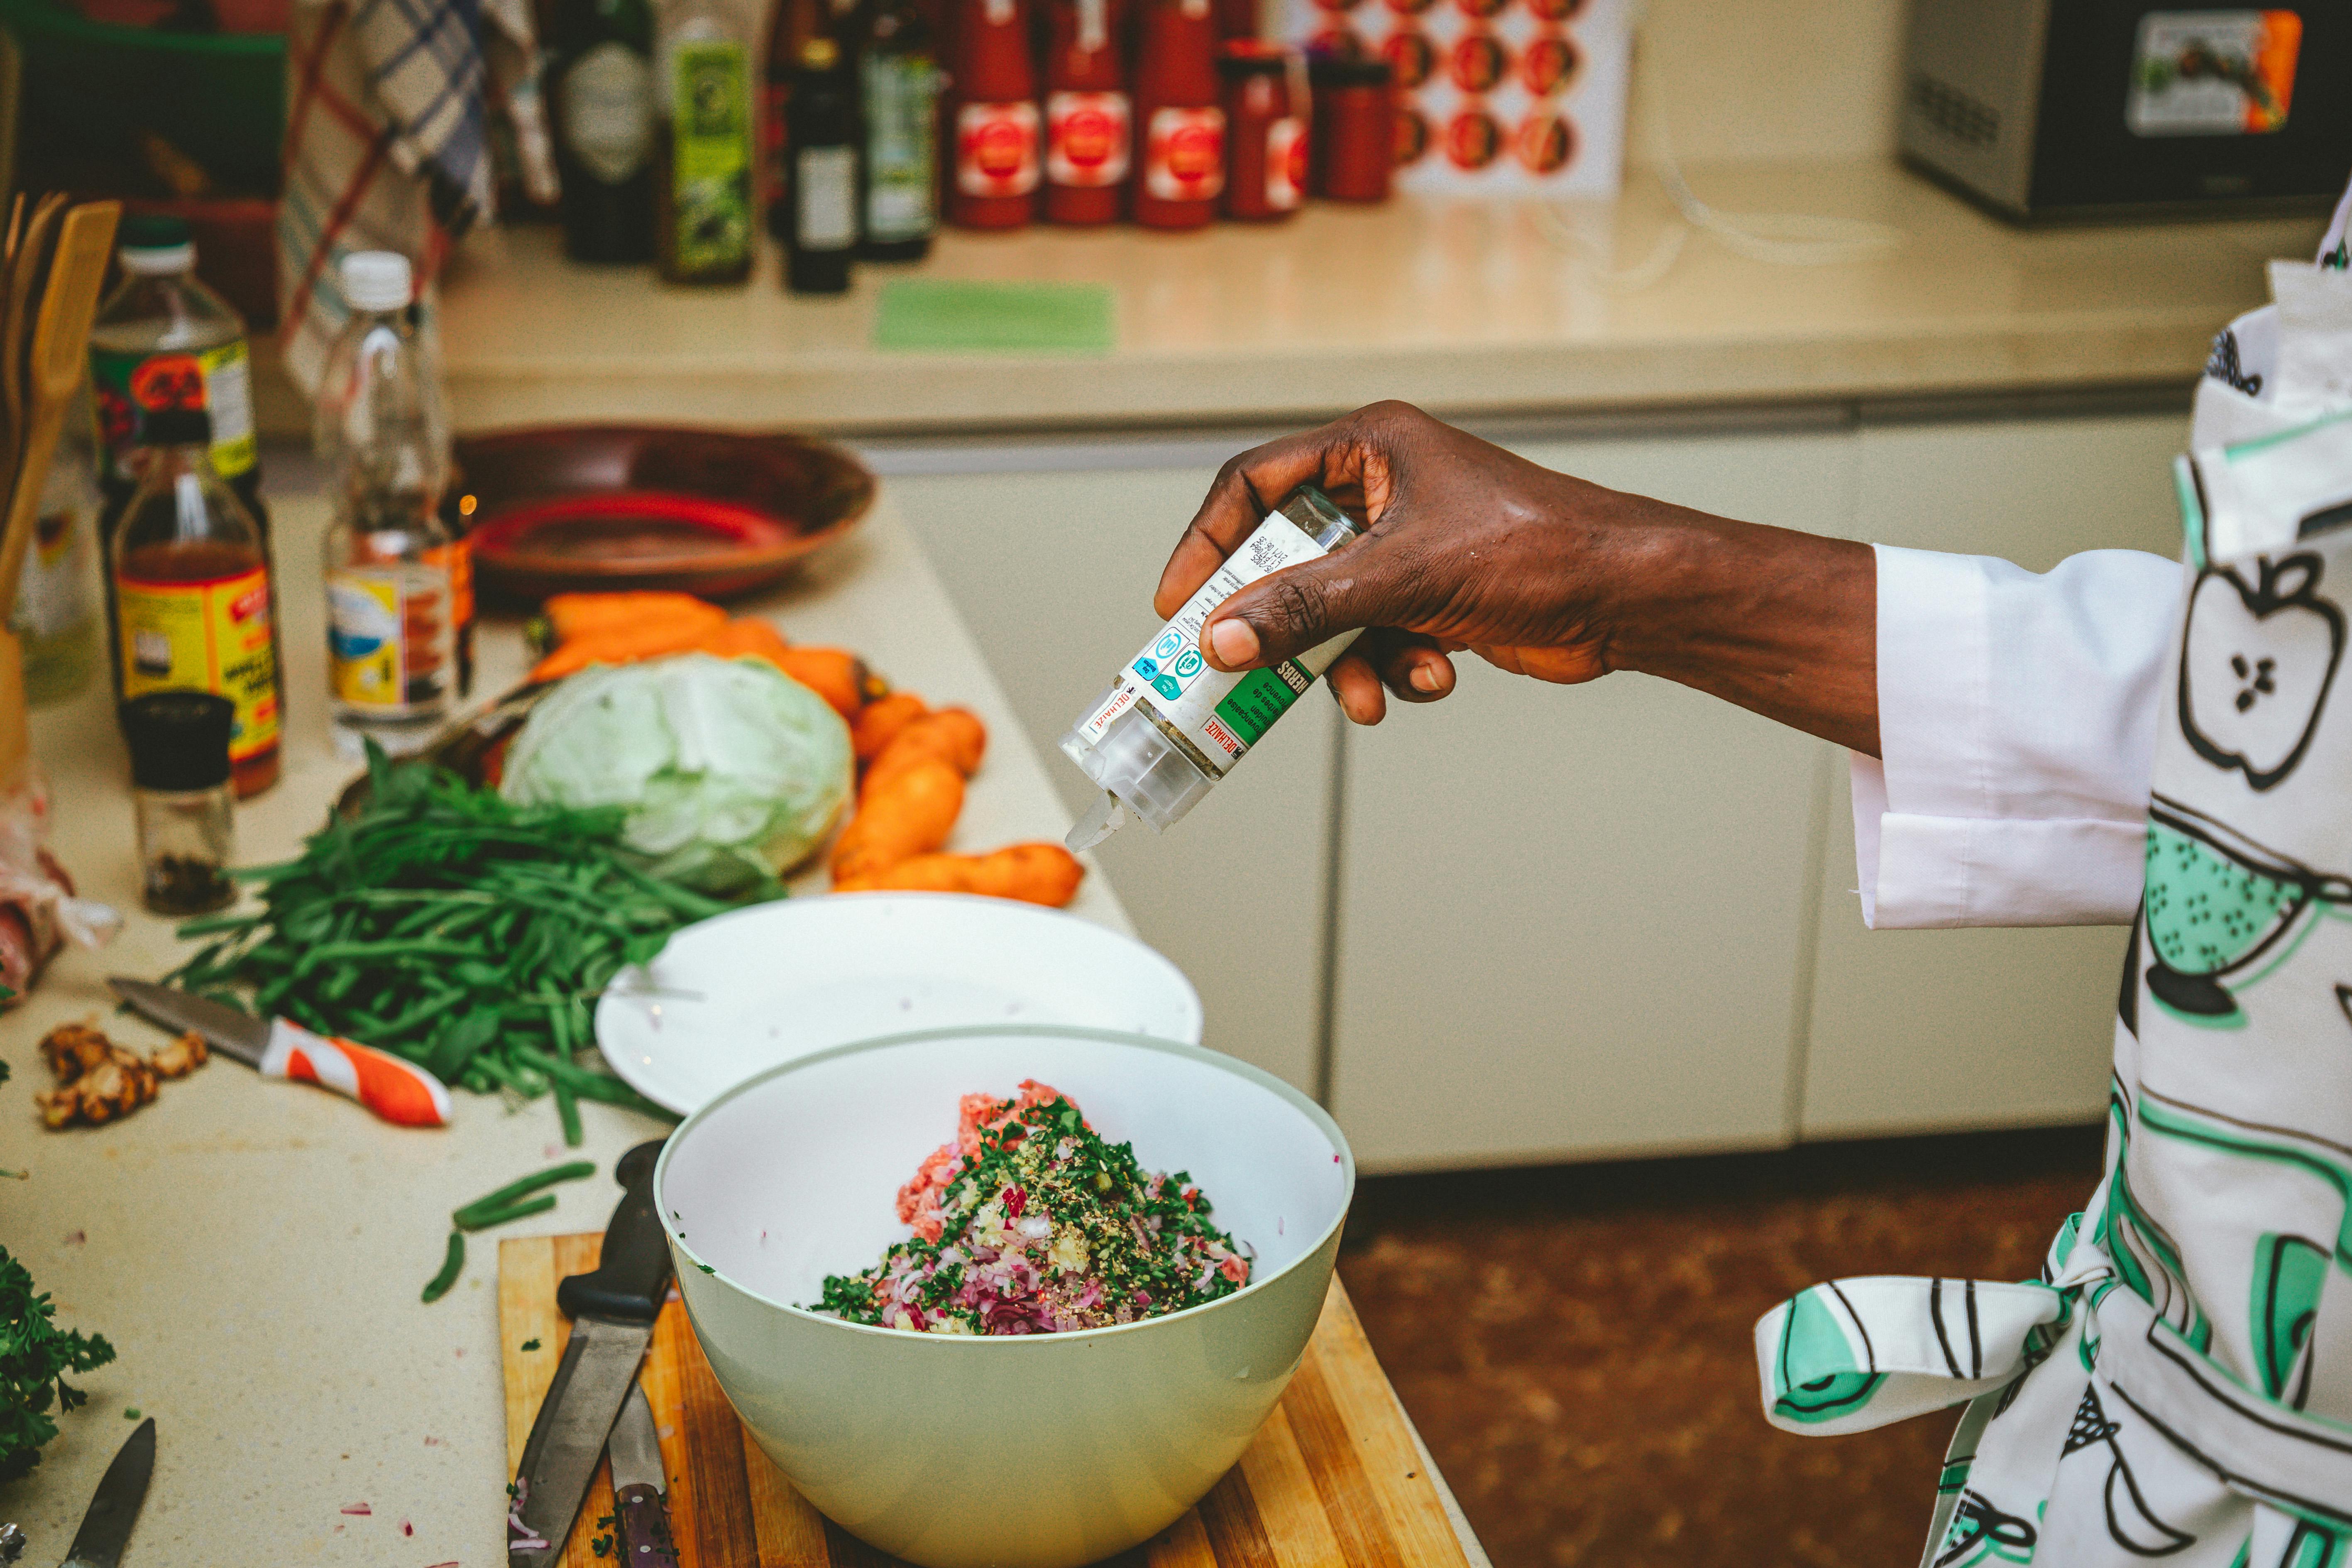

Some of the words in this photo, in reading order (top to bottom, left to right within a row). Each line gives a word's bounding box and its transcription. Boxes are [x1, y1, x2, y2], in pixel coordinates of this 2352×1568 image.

[1256, 535, 1274, 551] 06:35
[1271, 547, 1288, 562] 2171
[1250, 553, 1274, 574] 05/2025
[1142, 659, 1156, 672] Bouchon
[1276, 660, 1309, 694] HERBS
[1163, 678, 1175, 690] Flacon
[1252, 688, 1262, 698] de
[1262, 681, 1289, 708] Provence
[1094, 692, 1130, 728] DELHAIZE
[1226, 697, 1264, 736] Provençaalse
[1249, 704, 1271, 728] kruiden
[1260, 695, 1281, 718] Herbes
[1204, 720, 1237, 753] DELHAIZE
